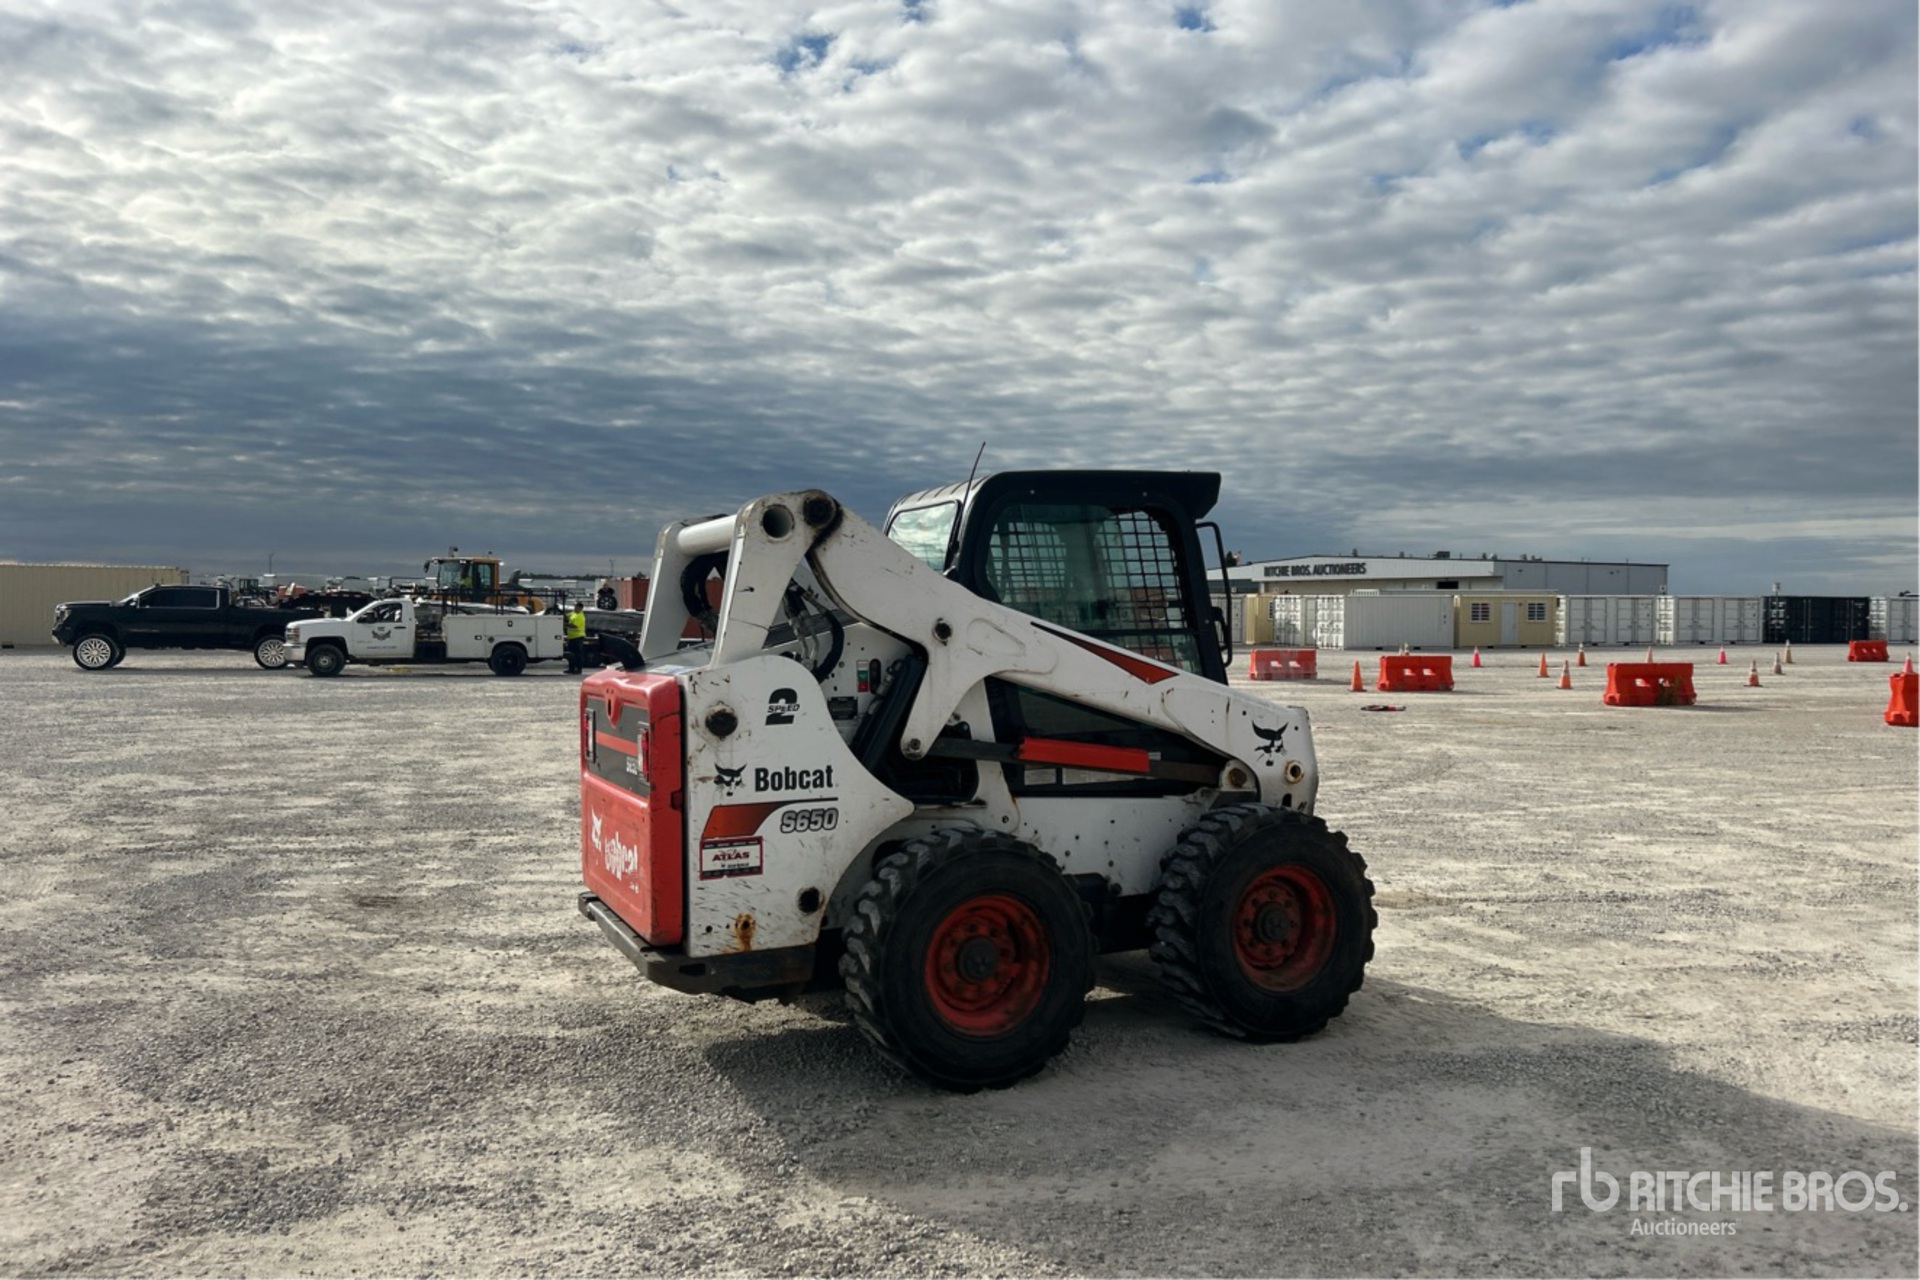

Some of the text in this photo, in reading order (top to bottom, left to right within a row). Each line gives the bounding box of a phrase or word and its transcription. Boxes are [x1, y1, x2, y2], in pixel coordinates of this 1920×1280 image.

[1263, 565, 1290, 577] RITCHIE
[1312, 562, 1367, 576] AUCTIONEERS
[754, 764, 834, 793] Bobcat
[780, 807, 839, 834] S650
[712, 851, 750, 862] ATLAS
